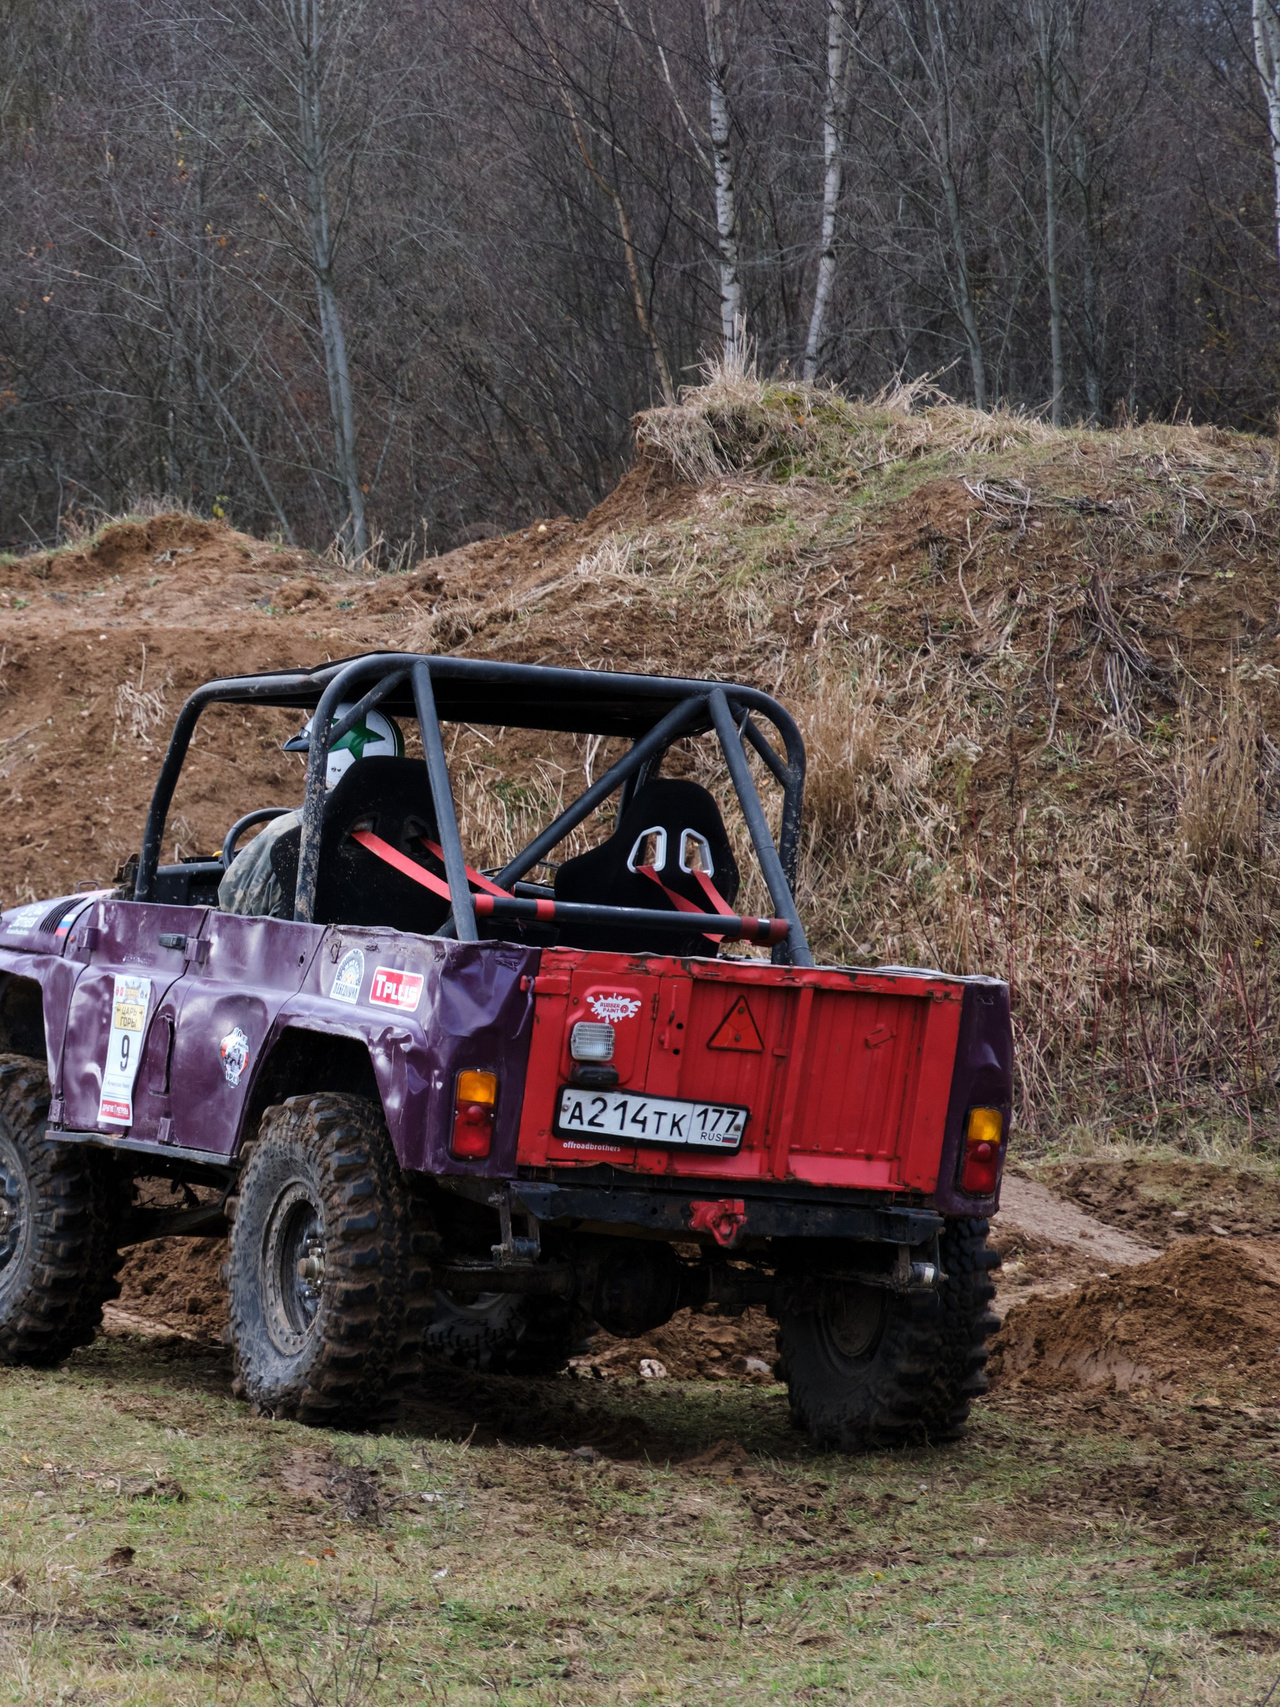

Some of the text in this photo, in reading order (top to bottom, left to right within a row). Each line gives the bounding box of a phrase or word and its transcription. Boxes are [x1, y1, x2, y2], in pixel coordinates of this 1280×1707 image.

[376, 974, 417, 1003] TPLUS
[121, 1005, 138, 1017] ЦАРЬ
[120, 1016, 138, 1028] ГОРЫ
[120, 1034, 130, 1072] 9
[696, 1108, 740, 1134] 177
[700, 1131, 722, 1142] RUS
[562, 1140, 621, 1152] offroadbrothers
